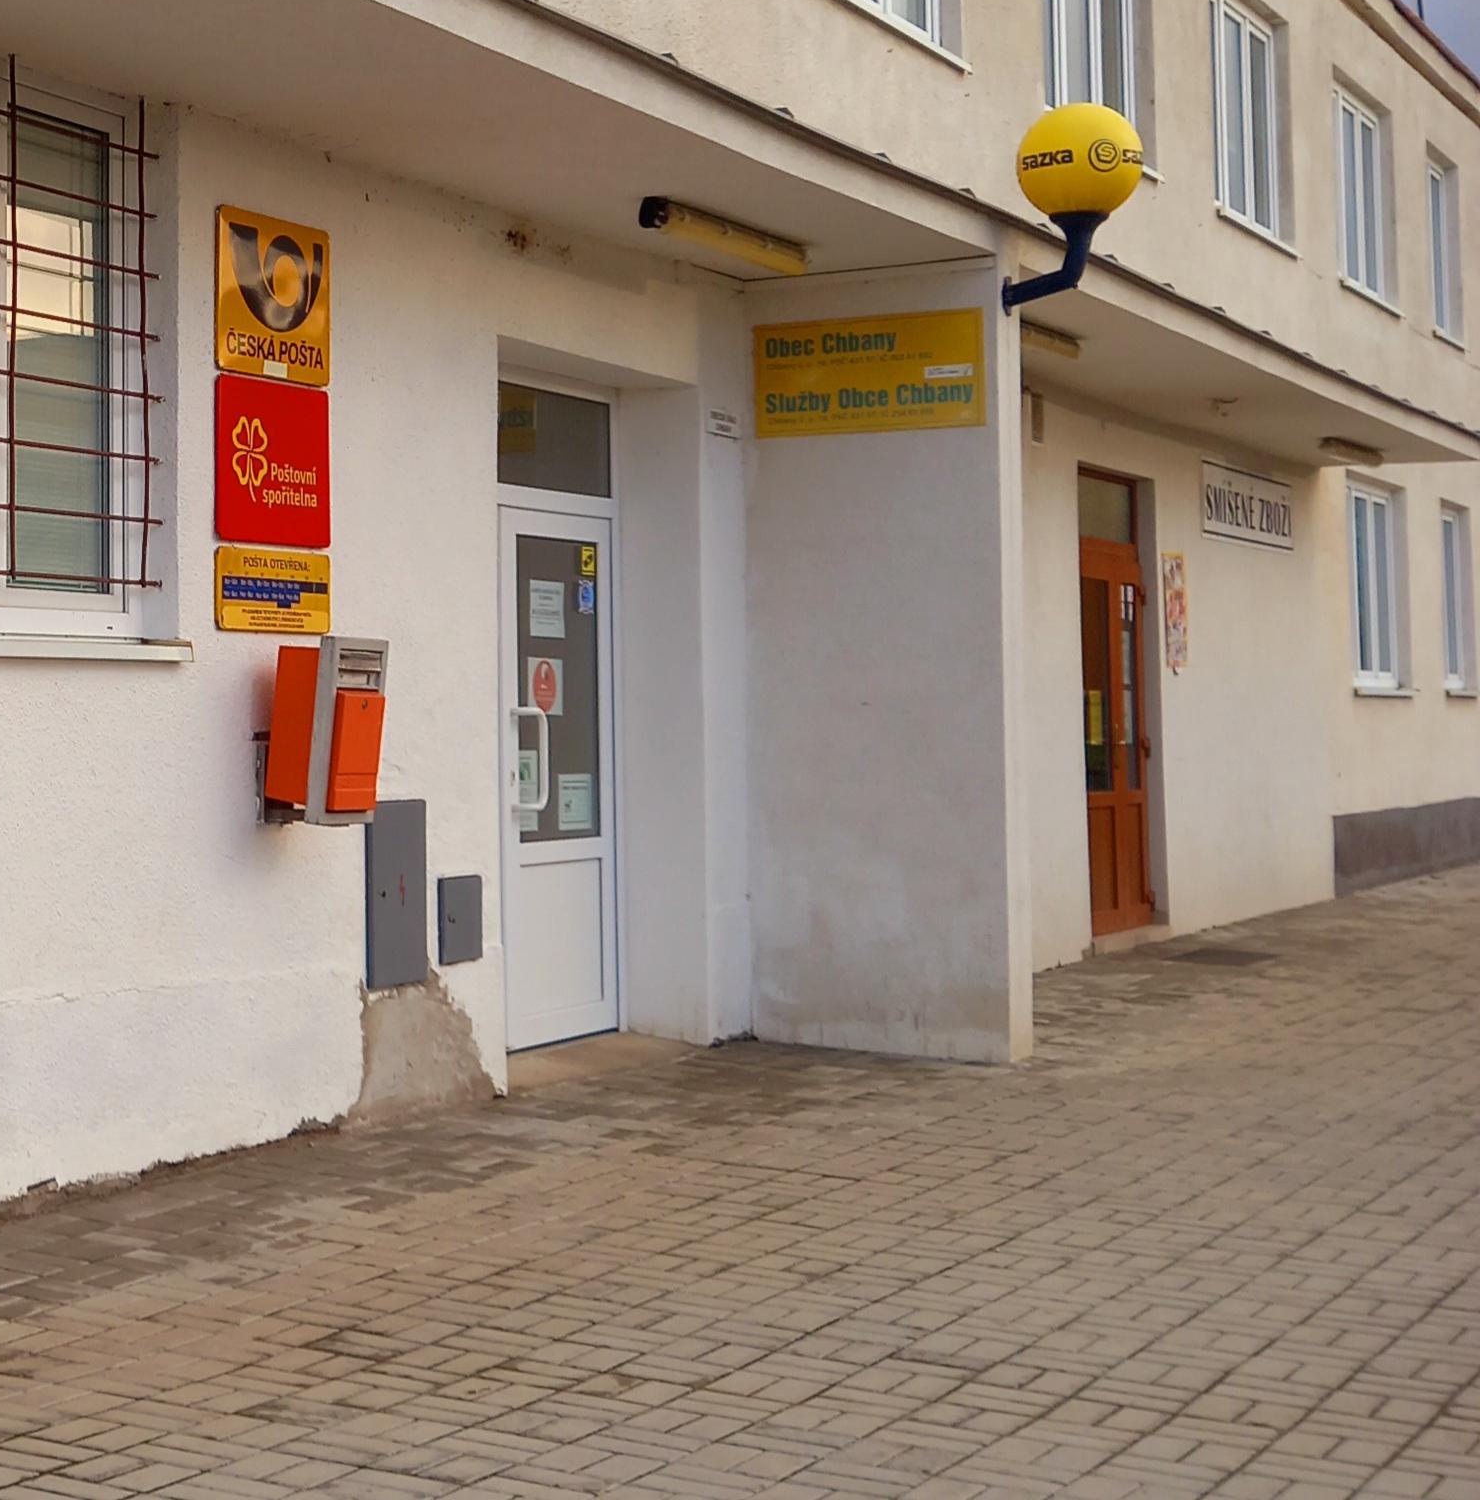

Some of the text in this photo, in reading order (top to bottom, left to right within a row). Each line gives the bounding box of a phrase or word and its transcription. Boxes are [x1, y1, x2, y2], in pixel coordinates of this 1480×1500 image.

[226, 327, 324, 370] ČESKÁ POŠTA
[765, 332, 897, 358] Obec Chbany
[765, 382, 974, 414] Služby Obce Chbany
[271, 462, 317, 485] Poštovní
[262, 485, 318, 509] spořitelna
[243, 555, 268, 569] POŠTA
